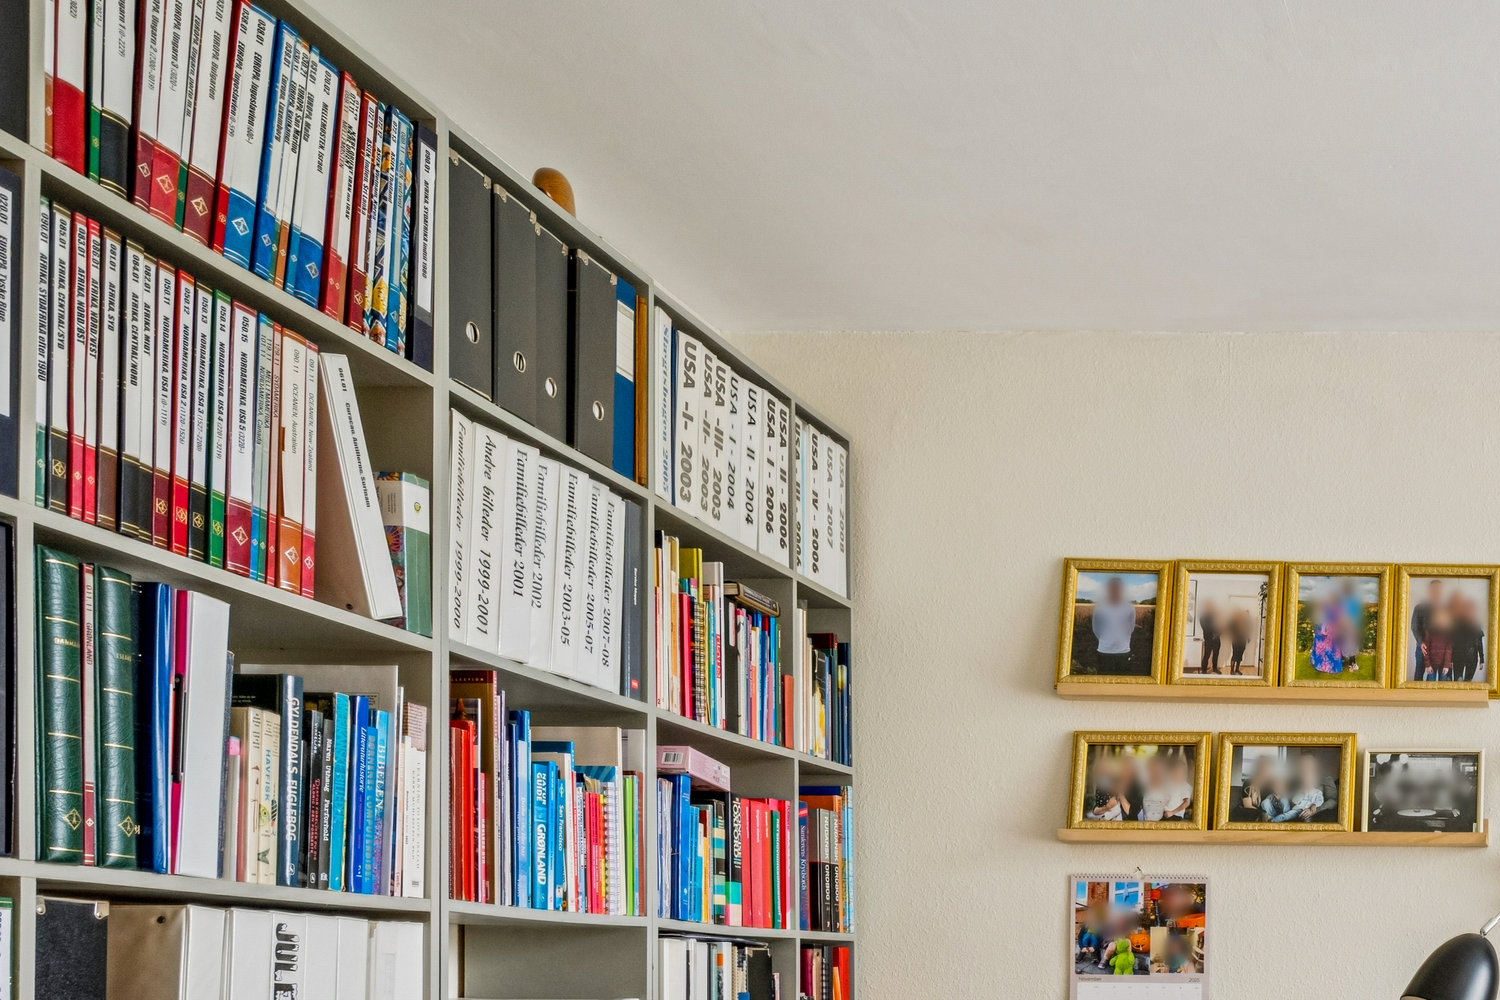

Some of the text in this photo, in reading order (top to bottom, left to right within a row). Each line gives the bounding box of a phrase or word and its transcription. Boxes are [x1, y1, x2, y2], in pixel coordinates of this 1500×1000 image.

[239, 8, 251, 33] 038.01
[255, 19, 268, 44] 038.01
[170, 31, 181, 61] Ungarn
[209, 62, 219, 100] Bulgarien
[230, 70, 243, 115] Jugoslavien
[247, 82, 260, 127] Jugoslavien
[322, 71, 332, 94] 070.02
[316, 150, 325, 173] Israel
[38, 213, 49, 381] 090.01 AFRIKA, SYDAFRIKA efter 1980
[57, 219, 67, 349] 085.01 AFRIKA, CENTRAL/SYD
[130, 254, 140, 386] 084.01 AFRIKA, CENTRAL/NORD
[161, 376, 169, 392] USA
[684, 341, 696, 388] USA
[160, 399, 168, 426] (0-1119)
[748, 388, 757, 425] USA
[767, 400, 775, 438] USA
[338, 368, 346, 392] 061.01
[360, 476, 371, 508] Surinam
[680, 442, 692, 502] 2003
[513, 449, 528, 597] Familiebilleder 2001
[745, 478, 754, 525] 2004
[766, 485, 774, 534] 2006
[477, 435, 497, 634] Andre billeder 1999-2001
[561, 472, 578, 646] Familiebilleder 2003-05
[602, 502, 615, 667] Familiebilleder 2007-08
[286, 697, 299, 841] GYLDENDALS FUGLEBOG
[324, 765, 332, 792] Uthaug
[359, 728, 367, 792] Litteraturhistorie
[376, 744, 386, 808] BIBELEN
[323, 800, 331, 841] Parforhold
[537, 824, 546, 884] GRØNLAND
